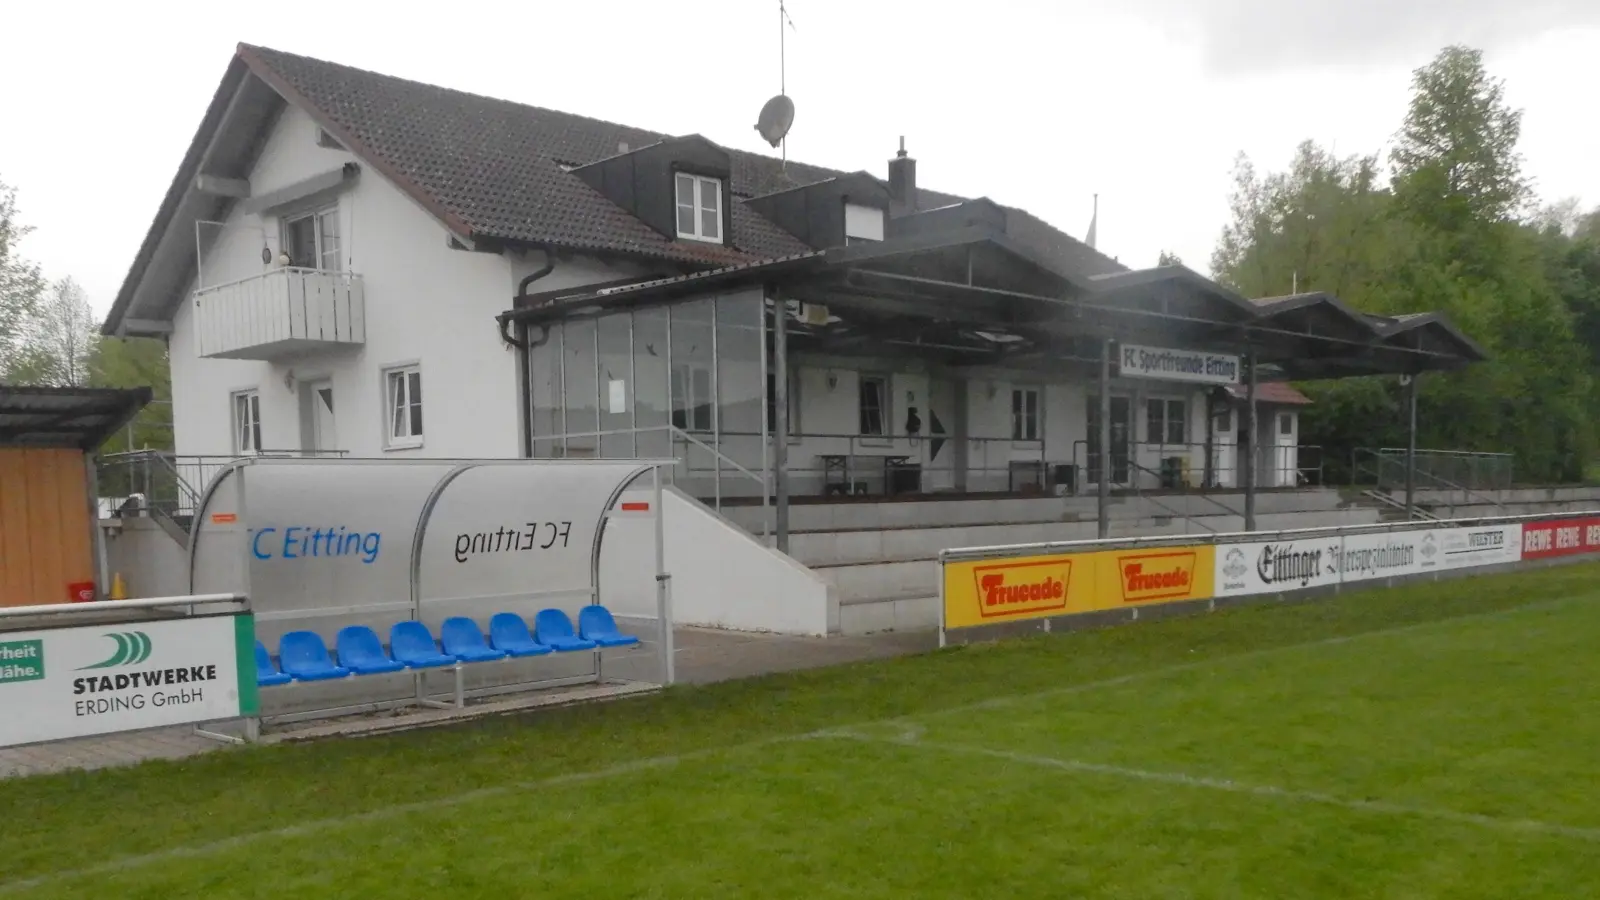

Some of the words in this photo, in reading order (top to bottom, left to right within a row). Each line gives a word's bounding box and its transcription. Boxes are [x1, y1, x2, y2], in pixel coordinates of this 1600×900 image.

[1123, 347, 1137, 369] FC
[1139, 349, 1204, 374] Sportfreunde
[247, 526, 276, 560] C
[282, 525, 381, 564] Eitting
[1524, 528, 1553, 552] REWE
[1556, 525, 1580, 549] REWE
[1124, 563, 1189, 592] Frucade
[1257, 544, 1322, 587] Eittinger
[981, 573, 1064, 607] Frucade
[0, 644, 36, 659] heit
[0, 664, 40, 679] ähe.
[73, 665, 217, 695] STADTWERKE
[75, 694, 145, 717] ERDING
[151, 687, 203, 707] GmbH
